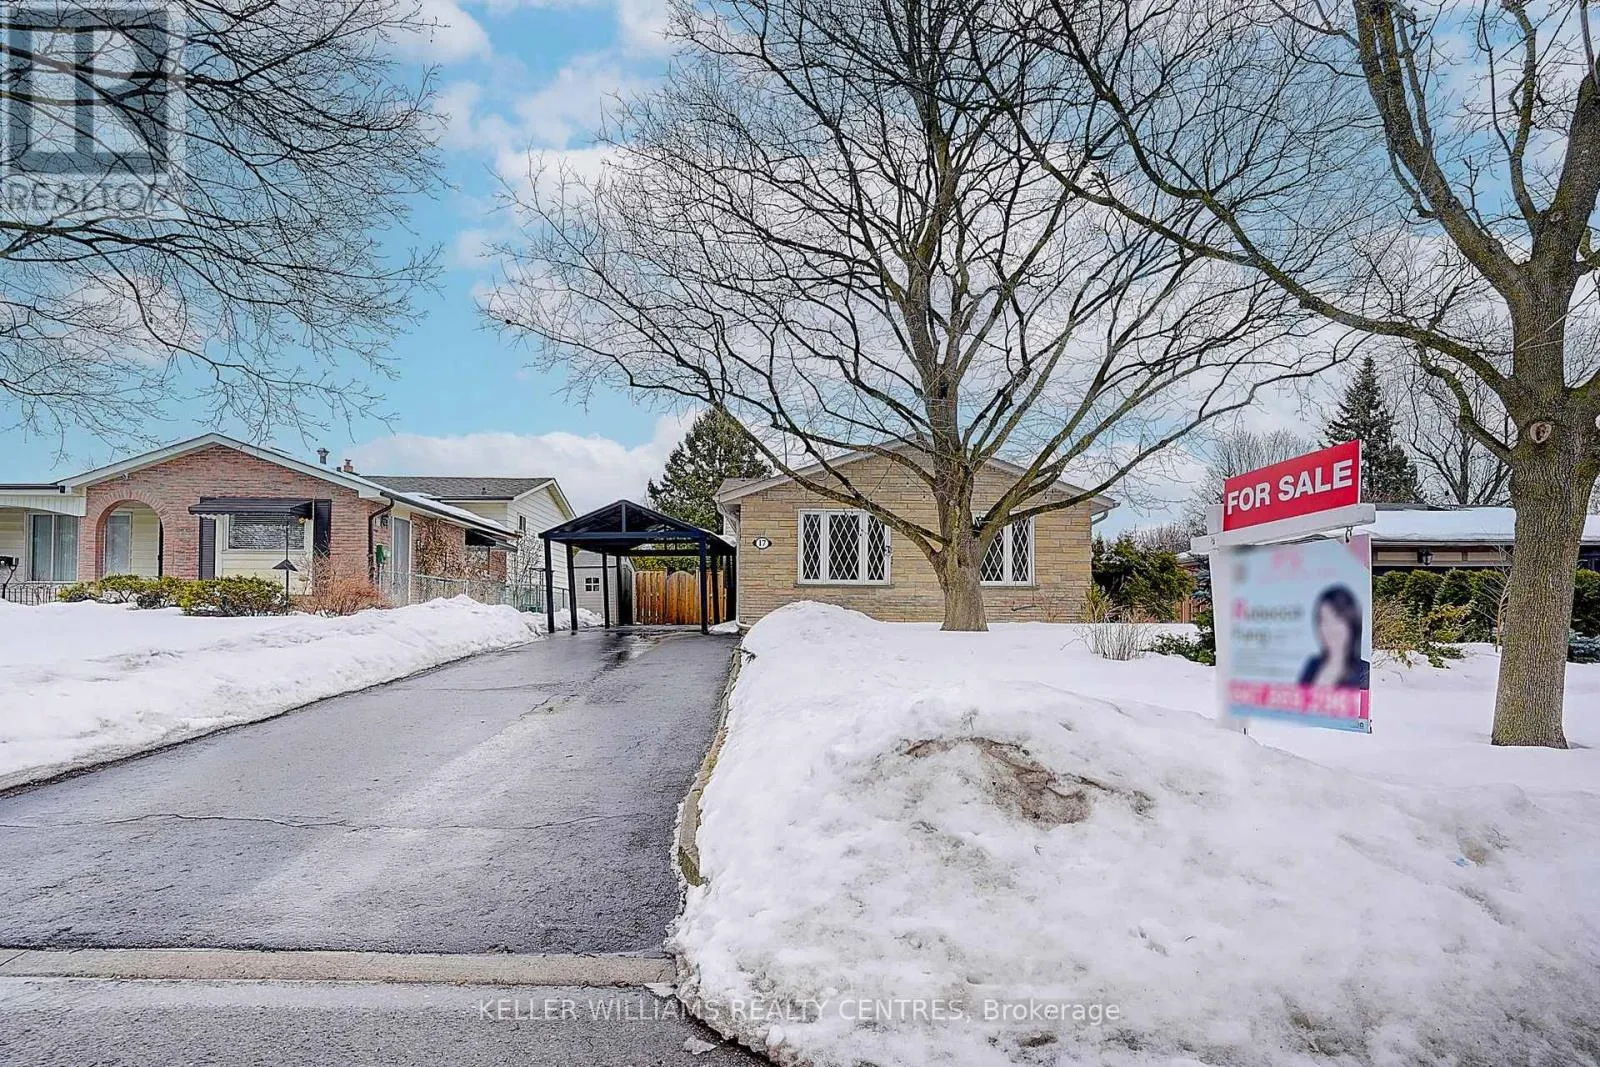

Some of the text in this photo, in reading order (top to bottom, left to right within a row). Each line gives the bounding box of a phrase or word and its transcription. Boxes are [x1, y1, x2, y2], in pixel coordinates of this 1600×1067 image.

[1227, 459, 1353, 515] FOR SALE
[759, 539, 767, 547] 17
